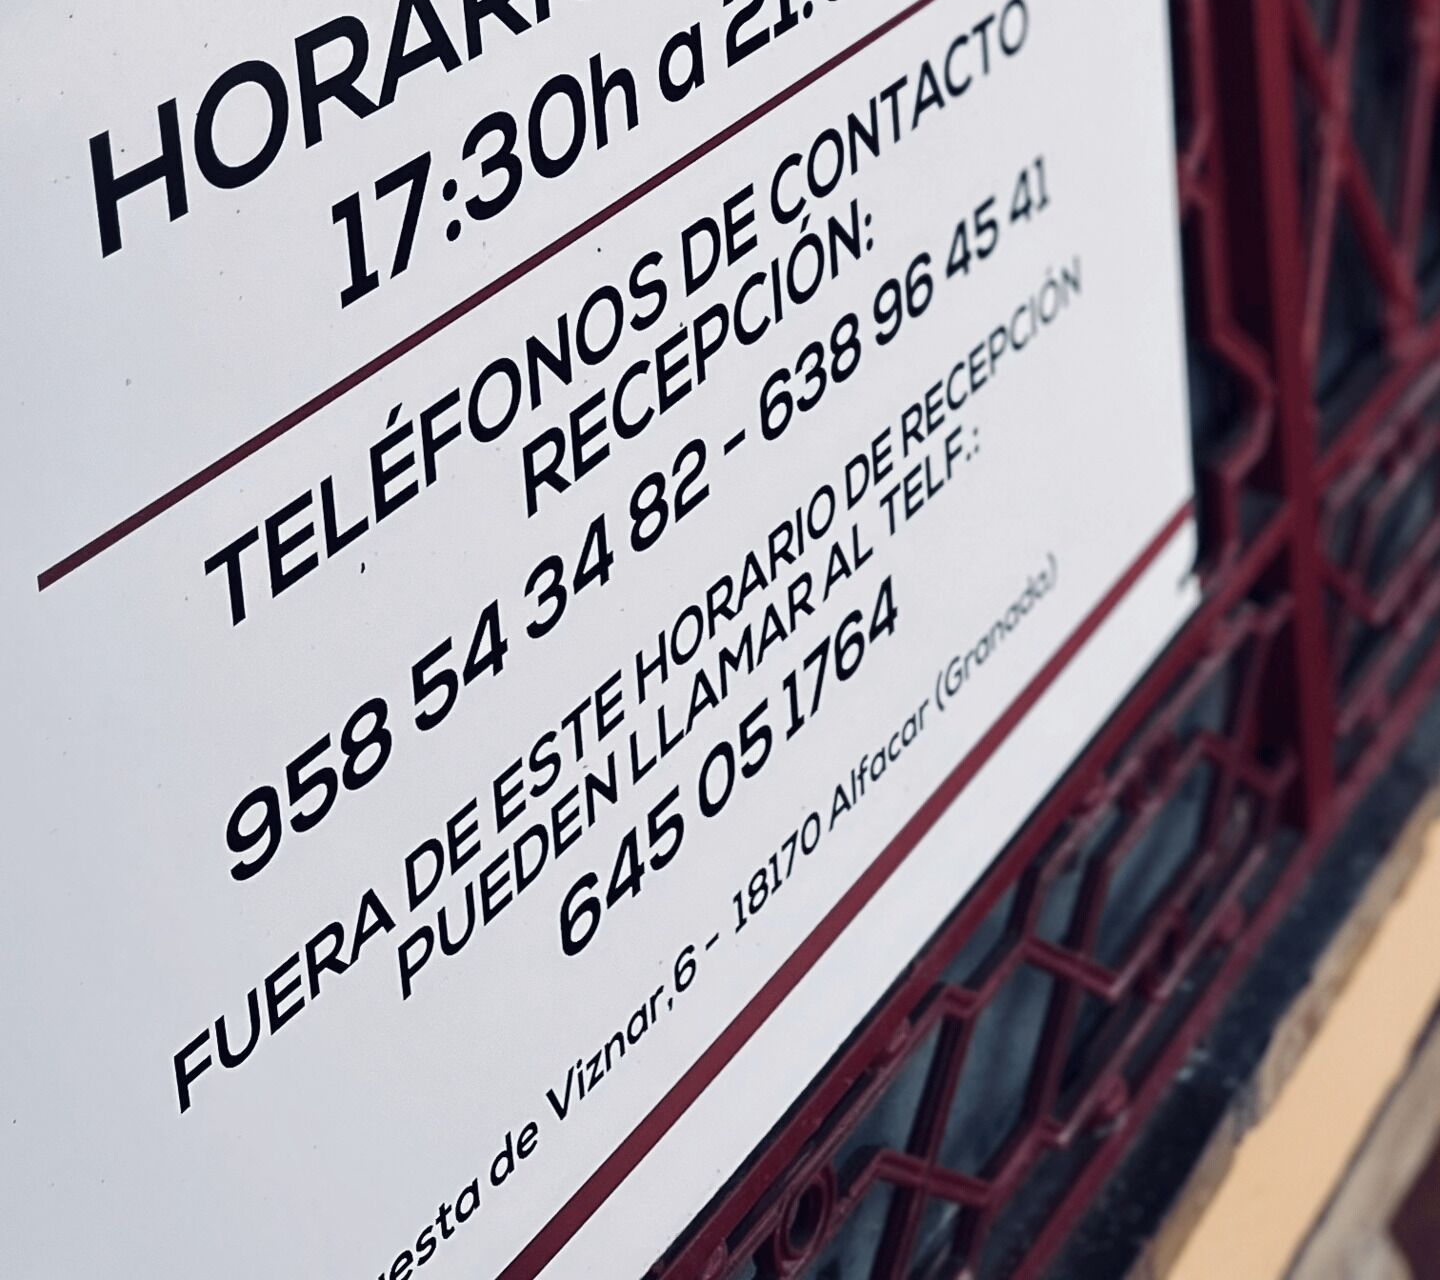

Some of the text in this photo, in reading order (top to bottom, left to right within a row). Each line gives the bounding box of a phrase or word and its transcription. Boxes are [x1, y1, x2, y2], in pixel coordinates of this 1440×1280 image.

[203, 250, 668, 627] TELÉFONOS
[680, 182, 758, 298] DE
[331, 52, 639, 310] 17:30h
[658, 21, 706, 103] a
[522, 198, 874, 519] RECEPCIÓN:
[173, 256, 1082, 1115] FUERA DE ESTE HORARIO DE RECEPCIÓN
[225, 155, 1049, 882] 958 54 34 82 - 638 96 45 41
[397, 425, 980, 1001] PUEDEN LLAMAR AL TELF.:
[376, 1177, 481, 1280] esta
[489, 1121, 539, 1187] de
[732, 811, 821, 934] 18170
[828, 698, 930, 832] Alfacar
[934, 552, 1058, 711] (Granada)
[559, 784, 685, 957] 645
[698, 697, 773, 818] 05
